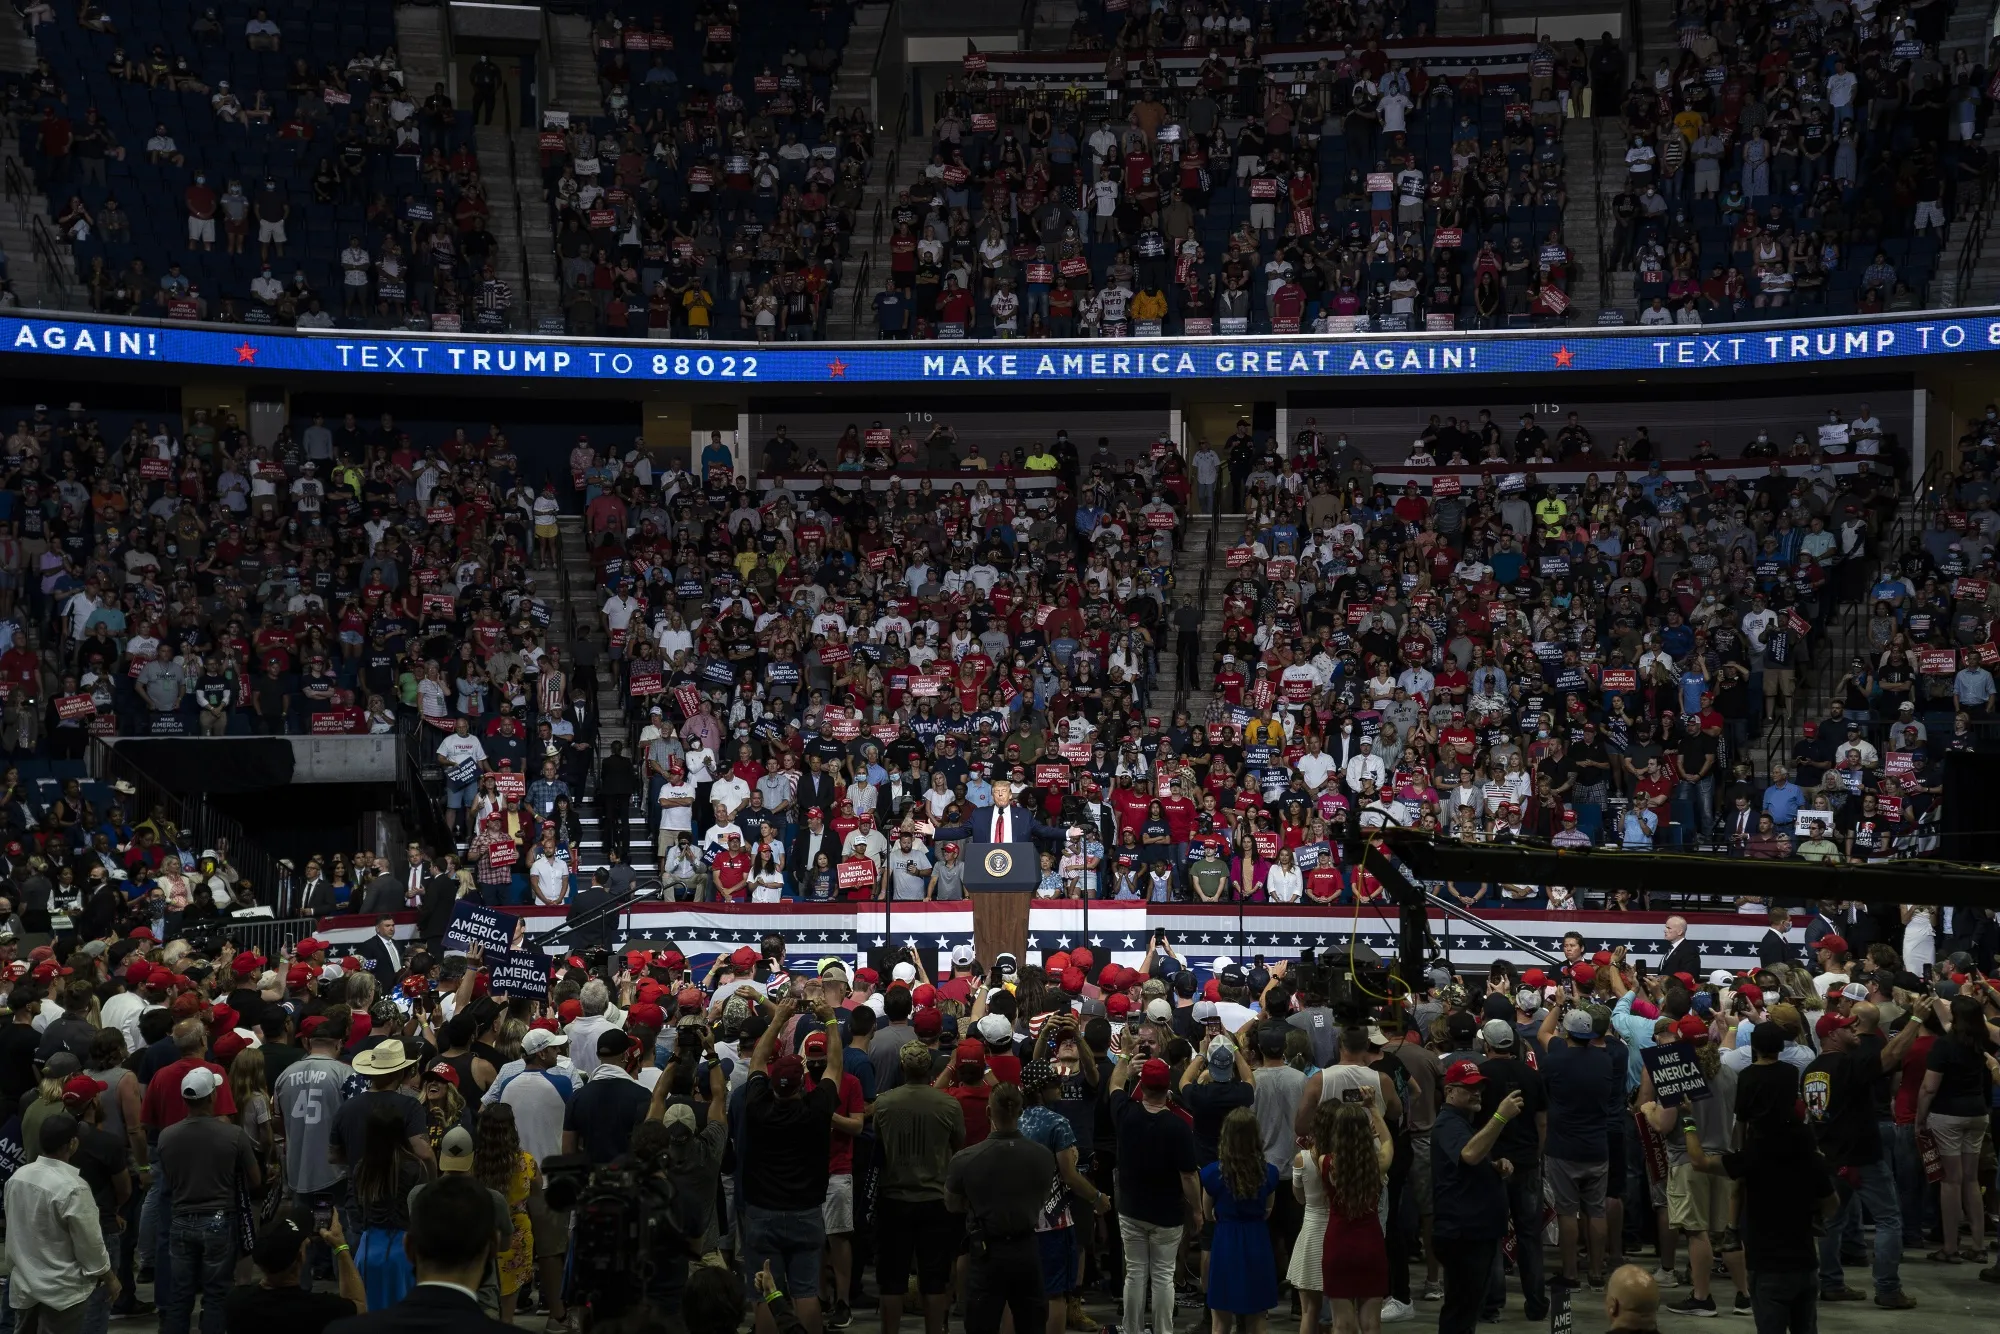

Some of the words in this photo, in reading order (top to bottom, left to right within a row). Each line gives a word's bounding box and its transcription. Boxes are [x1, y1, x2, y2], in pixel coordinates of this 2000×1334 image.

[14, 324, 156, 355] AGAIN!
[1654, 339, 1746, 363] TEXT
[1765, 330, 1894, 357] TRUMP
[1916, 326, 1965, 348] TO
[336, 344, 428, 368] TEXT
[448, 349, 570, 372] TRUMP
[590, 352, 632, 374] TO
[652, 354, 758, 377] 88022
[924, 355, 1017, 376] MAKE
[1036, 352, 1196, 374] AMERICA
[1216, 350, 1330, 372] GREAT
[1350, 347, 1476, 370] AGAIN!
[822, 650, 848, 659] AMERICA
[706, 666, 732, 676] AMERICA
[60, 701, 92, 711] AMERICA
[492, 849, 514, 858] AMERICA
[840, 870, 872, 878] AMERICA
[471, 912, 496, 926] MAKE
[451, 918, 508, 943] AMERICA
[448, 931, 478, 943] GREAT
[478, 939, 507, 953] AGAIN
[510, 958, 534, 967] MAKE
[493, 967, 546, 982] AMERICA
[522, 984, 546, 992] AGAIN
[1658, 1052, 1680, 1065] MAKE
[289, 1070, 327, 1086] TRUMP
[1653, 1062, 1700, 1083] AMERICA
[1658, 1084, 1680, 1096] GREAT
[1681, 1078, 1705, 1091] AGAIN
[291, 1089, 322, 1124] 45
